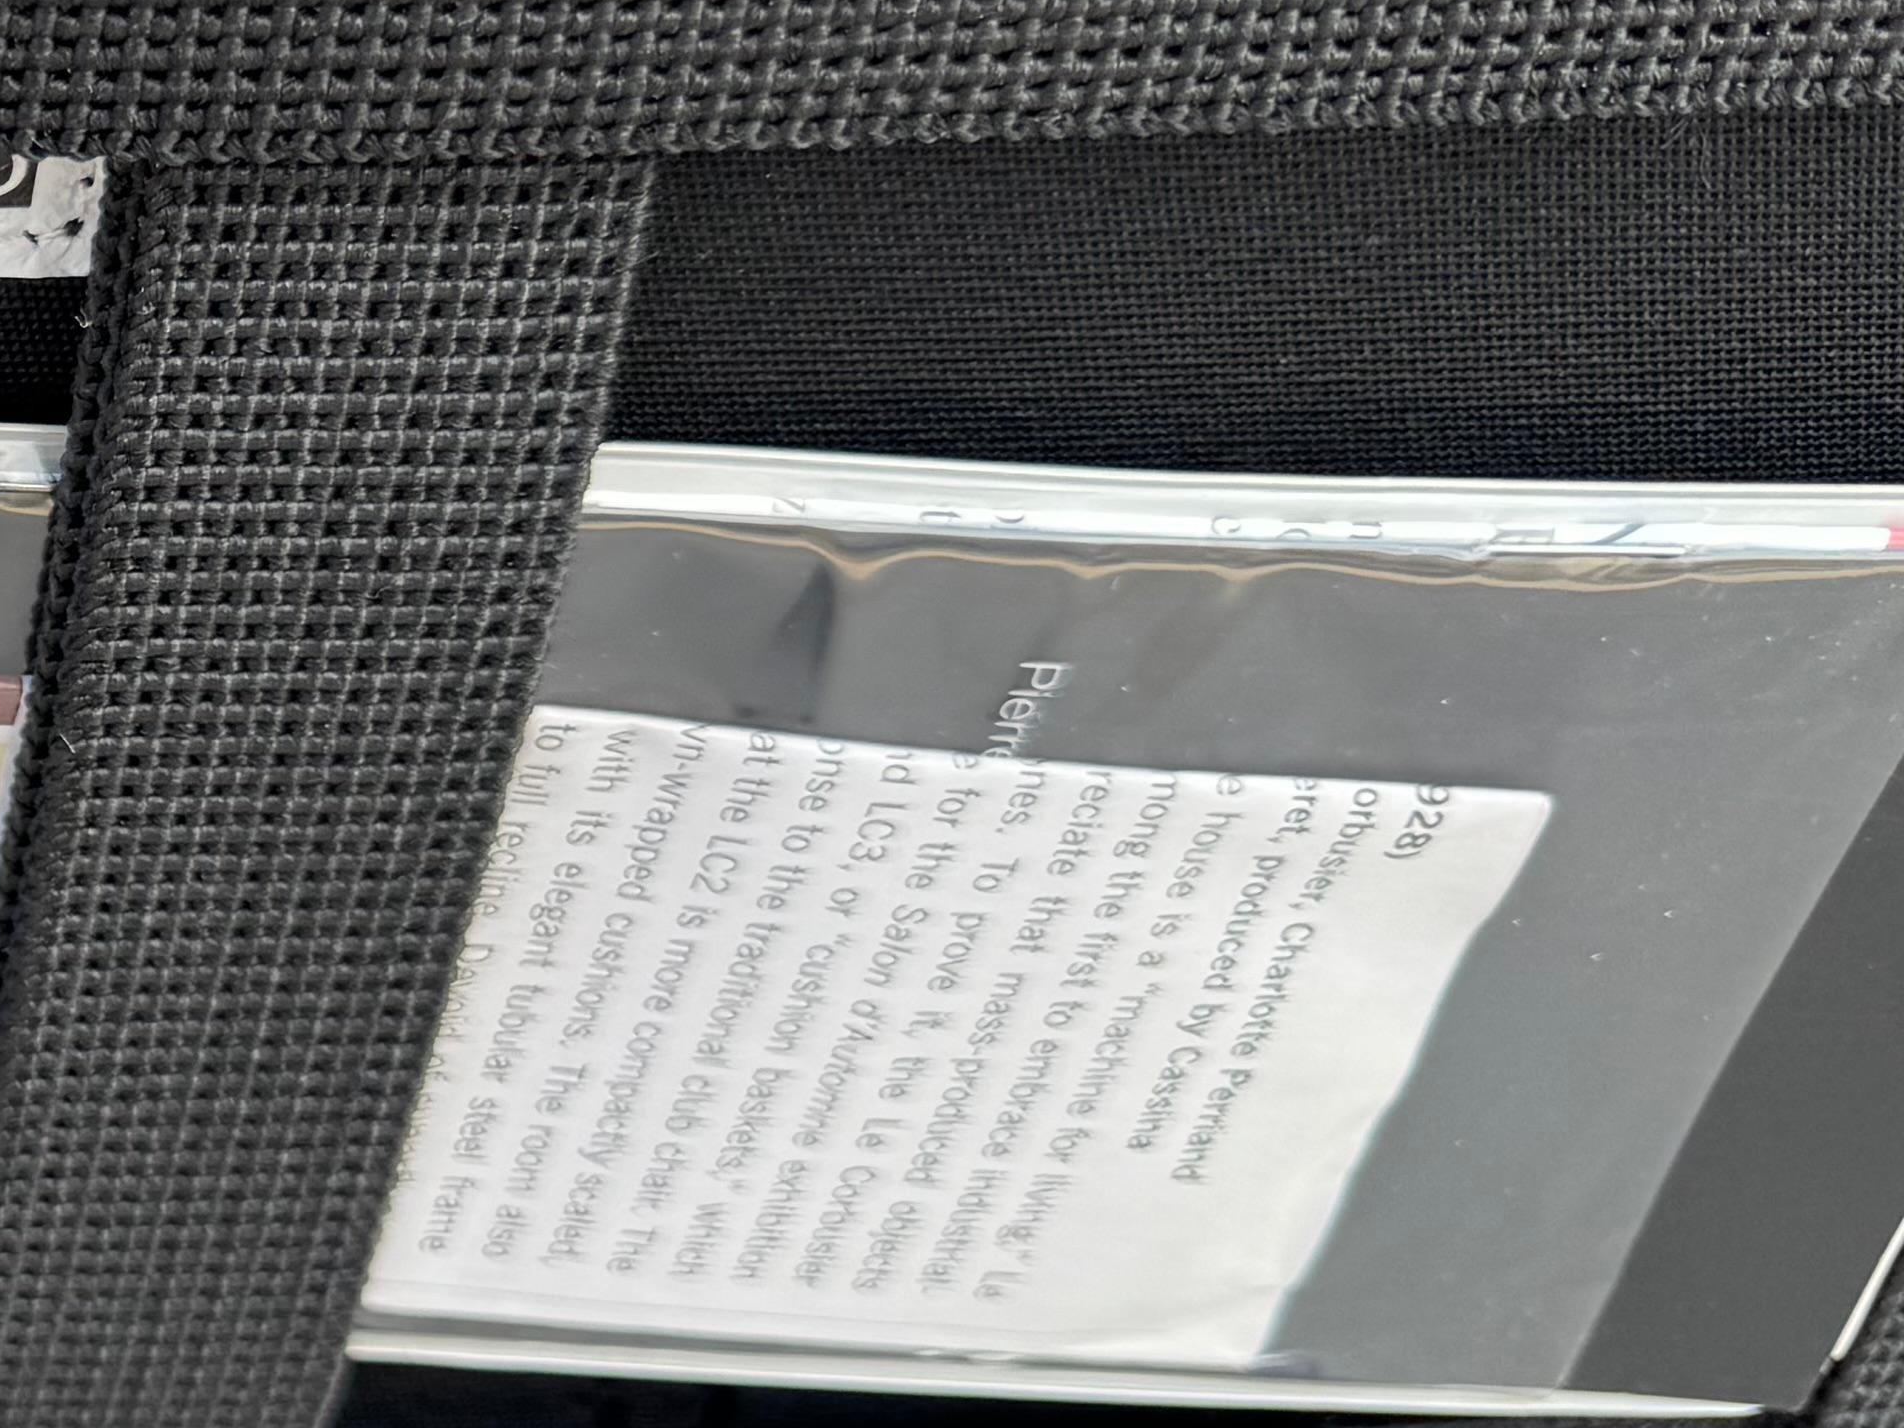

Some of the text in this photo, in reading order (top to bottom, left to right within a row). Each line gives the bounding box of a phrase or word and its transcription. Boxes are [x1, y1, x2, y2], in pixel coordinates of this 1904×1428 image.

[534, 725, 578, 751] to
[510, 764, 564, 804] full
[720, 778, 771, 823] the
[930, 788, 979, 828] for
[687, 835, 750, 893] LC2
[782, 824, 832, 853] to
[837, 802, 906, 873] LC3,
[904, 843, 952, 889] the
[1164, 812, 1245, 899] house
[755, 865, 806, 910] the
[824, 887, 866, 917] or
[971, 857, 1020, 894] To
[1092, 872, 1142, 919] the
[675, 905, 719, 928] is
[1149, 913, 1188, 937] is
[1199, 856, 1286, 990] produced
[644, 938, 697, 1012] more
[864, 905, 929, 987] Salon
[925, 913, 988, 993] prove
[1062, 932, 1119, 990] first
[1136, 952, 1168, 967] a
[419, 730, 642, 1253] with its elegant tubular steel frame
[560, 913, 642, 1047] cushions.
[693, 922, 782, 1063] traditional
[1230, 924, 1315, 1057] Charlotte
[850, 771, 1117, 1291] reciate that mass-produced objects
[901, 1011, 954, 1037] it,
[1043, 1000, 1090, 1028] to
[1176, 1004, 1226, 1036] by
[535, 1062, 592, 1114] The
[578, 1021, 664, 1170] compactly
[664, 1074, 716, 1135] club
[879, 1056, 930, 1099] the
[980, 1039, 1062, 1157] embrace
[1126, 1046, 1202, 1151] Cassina
[856, 1117, 905, 1148] Le
[1045, 1128, 1094, 1162] for
[1171, 1068, 1253, 1183] Perriand
[510, 1125, 557, 1195] room
[632, 1143, 687, 1213] chair.
[482, 1204, 527, 1259] also
[540, 1173, 611, 1269] scaled,
[669, 1203, 730, 1280] which
[730, 1160, 813, 1280] exhibition
[795, 1164, 876, 1288] Corbusier
[917, 1168, 1007, 1295] industrial-
[606, 1226, 660, 1273] The
[973, 1271, 1027, 1299] Le
